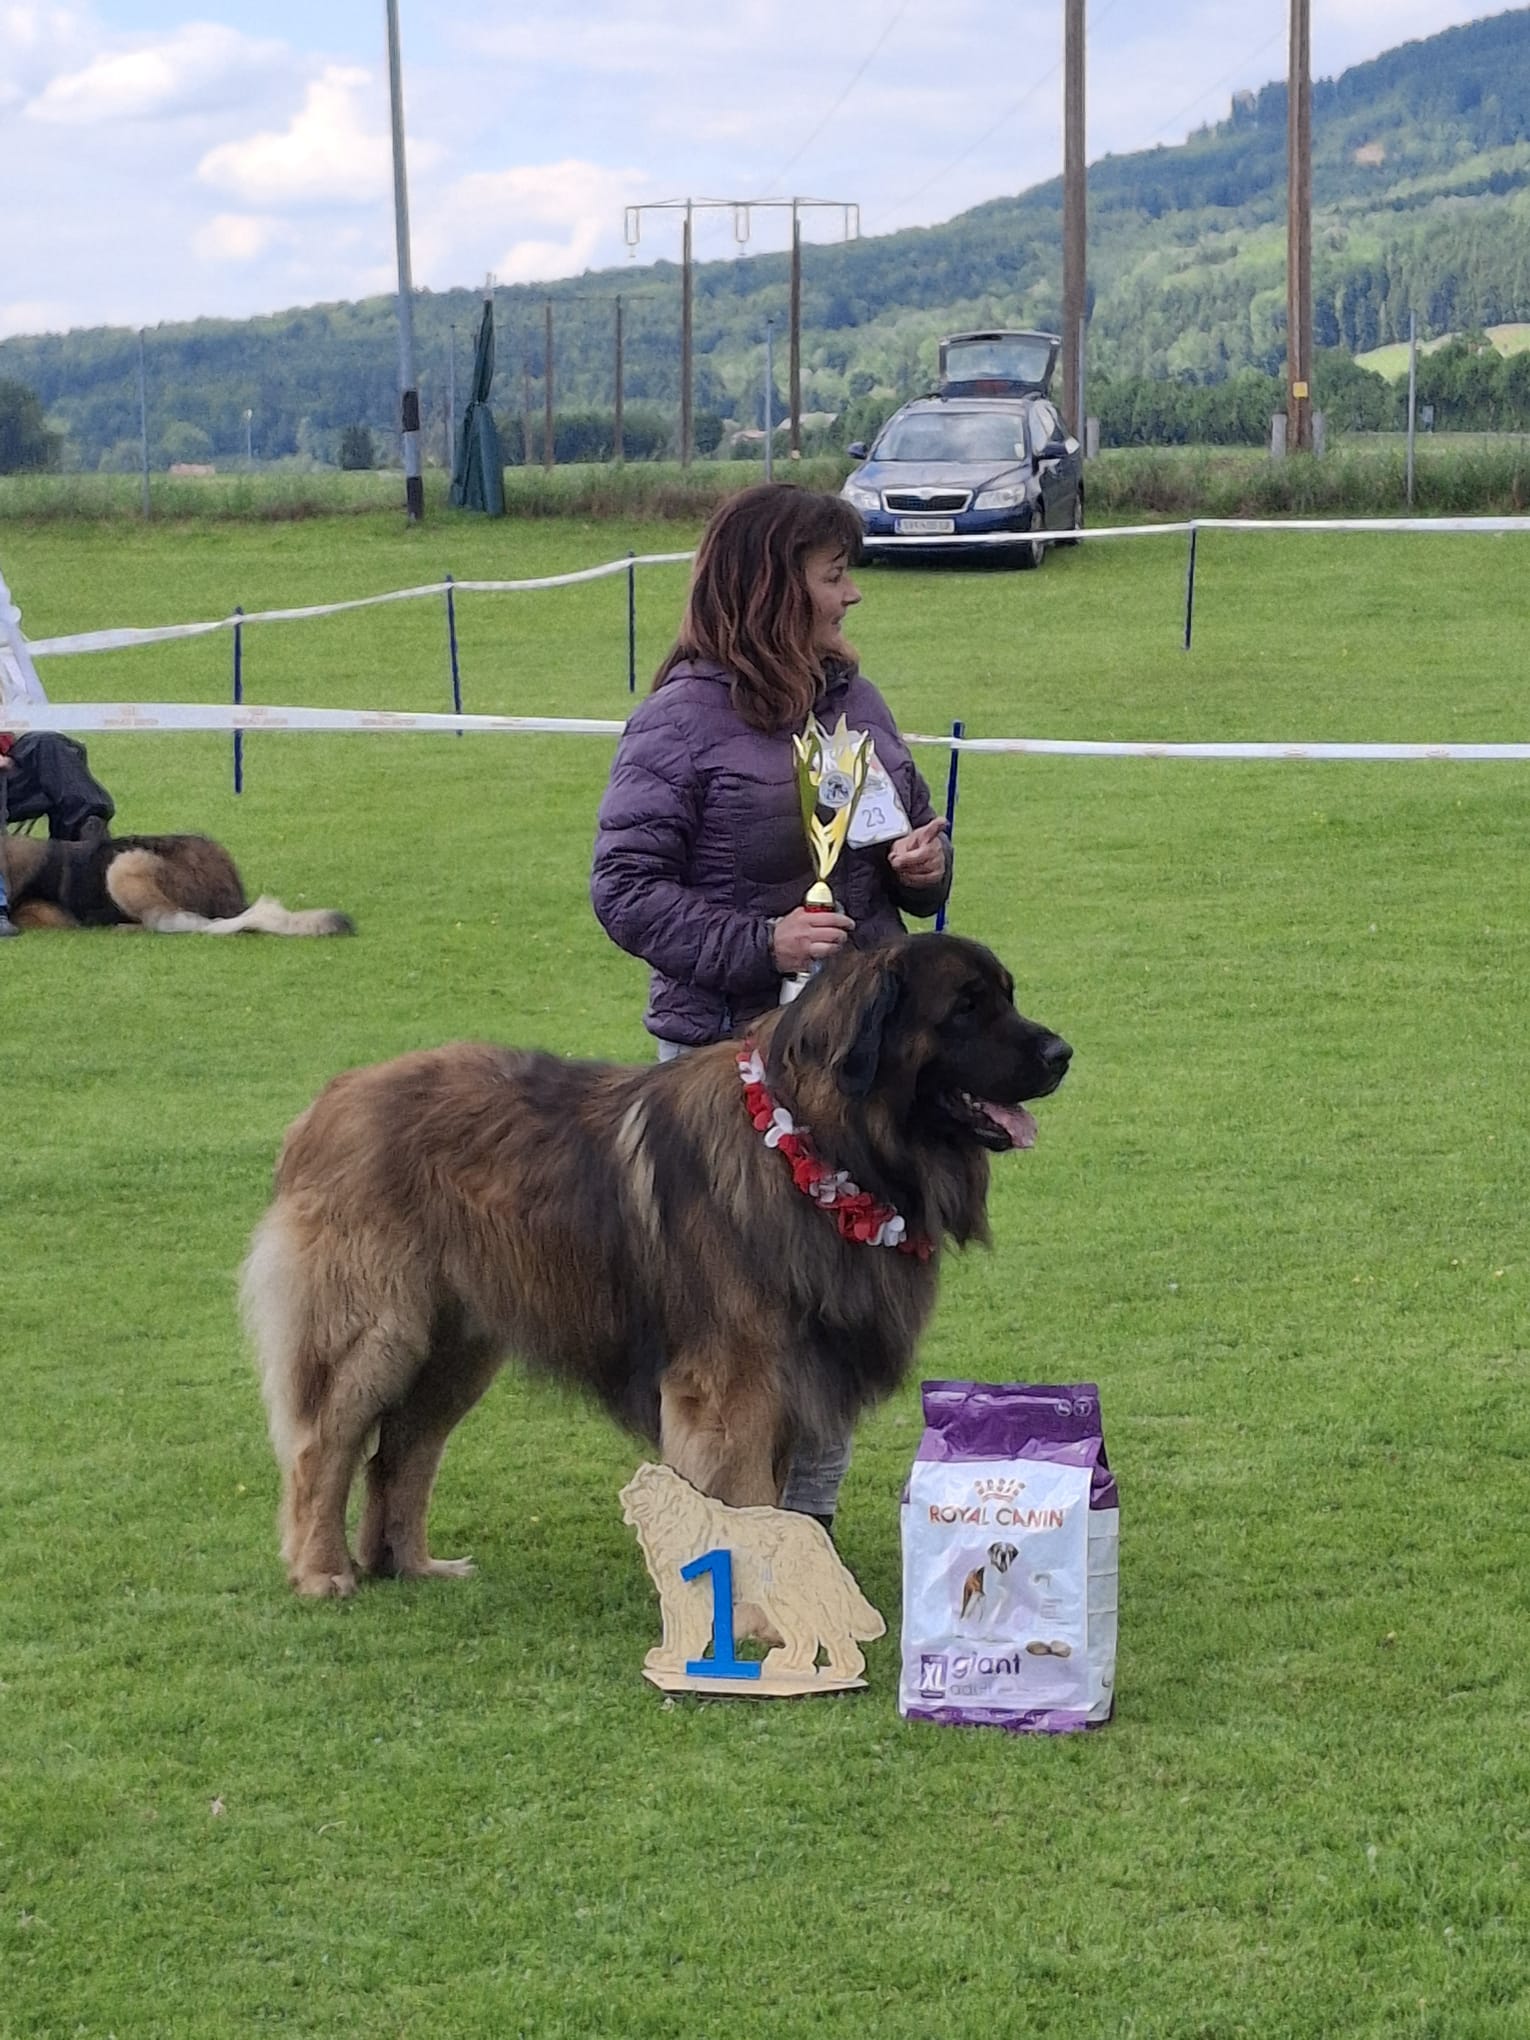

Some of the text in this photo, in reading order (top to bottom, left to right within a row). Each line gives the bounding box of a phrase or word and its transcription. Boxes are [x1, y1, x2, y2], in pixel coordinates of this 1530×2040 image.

[861, 806, 886, 828] 23
[929, 1504, 1064, 1528] ROYAL CANIN
[679, 1548, 762, 1681] 1
[920, 1662, 946, 1691] XL
[951, 1651, 1022, 1680] giant
